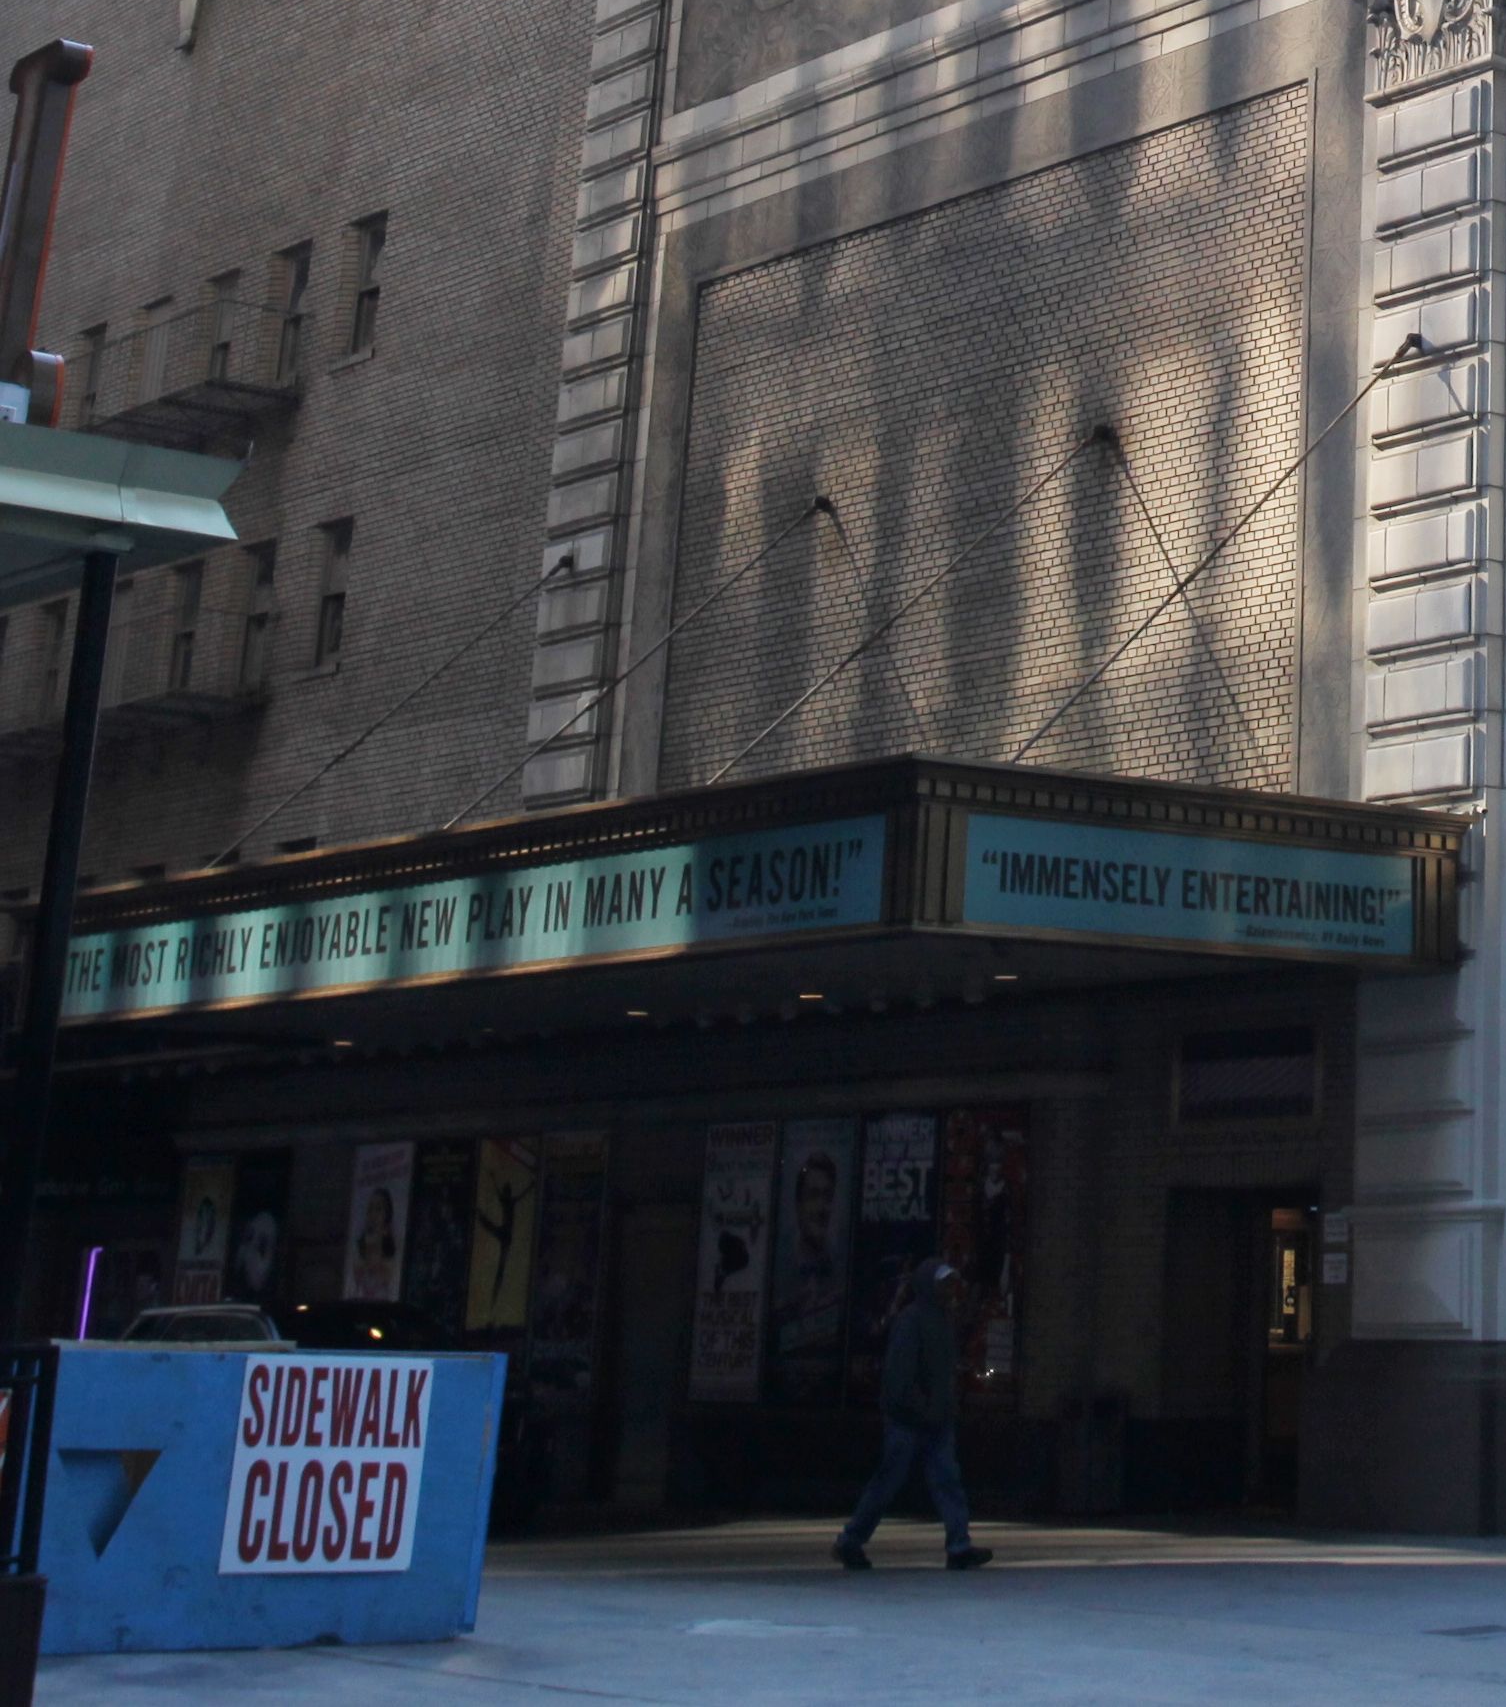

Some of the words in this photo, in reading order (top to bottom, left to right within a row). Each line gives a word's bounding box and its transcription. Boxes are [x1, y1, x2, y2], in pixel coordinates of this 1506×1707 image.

[70, 948, 105, 993] THE
[113, 939, 168, 989] MOST
[175, 926, 254, 982] RICHLY
[260, 905, 391, 970] ENJOYABLE
[401, 895, 454, 953] NEW
[467, 881, 533, 943] PLAY
[543, 876, 572, 932] IN
[583, 866, 668, 925] MANY
[676, 862, 694, 917] A
[863, 1161, 932, 1198] BEST
[242, 1364, 428, 1451] SIDEWALK
[236, 1459, 409, 1563] CLOSED
